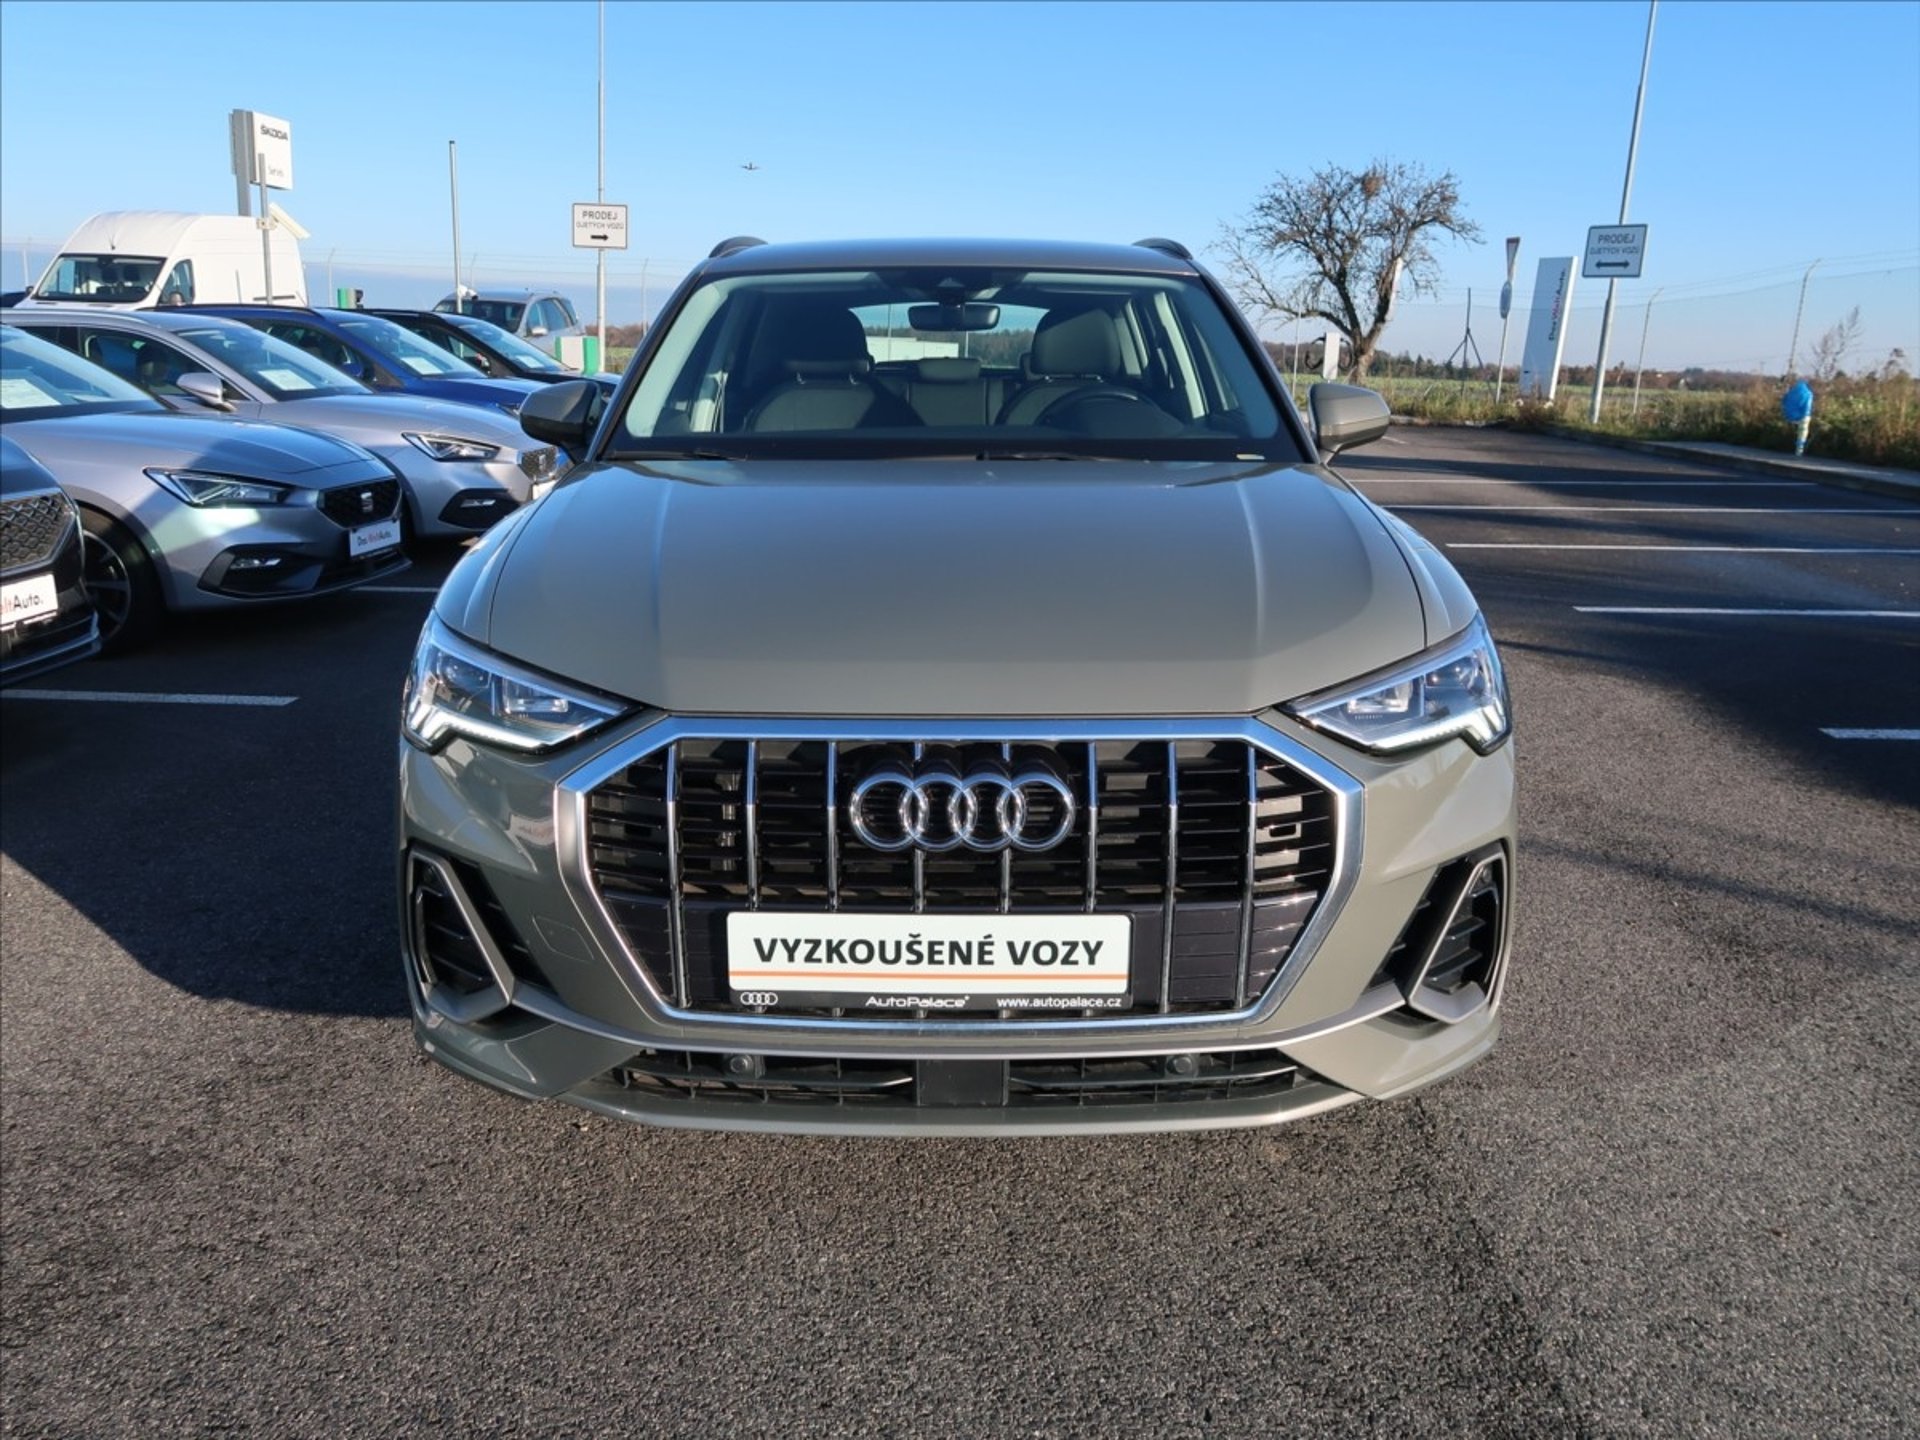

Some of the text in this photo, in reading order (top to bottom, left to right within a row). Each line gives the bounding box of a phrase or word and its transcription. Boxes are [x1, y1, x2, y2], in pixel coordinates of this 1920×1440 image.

[582, 210, 618, 221] PRODEJ
[1597, 232, 1636, 244] PRODEJ
[753, 933, 1104, 966] VYZKOUŠENÉ VOZY
[996, 996, 1122, 1009] www.autopalace.cz
